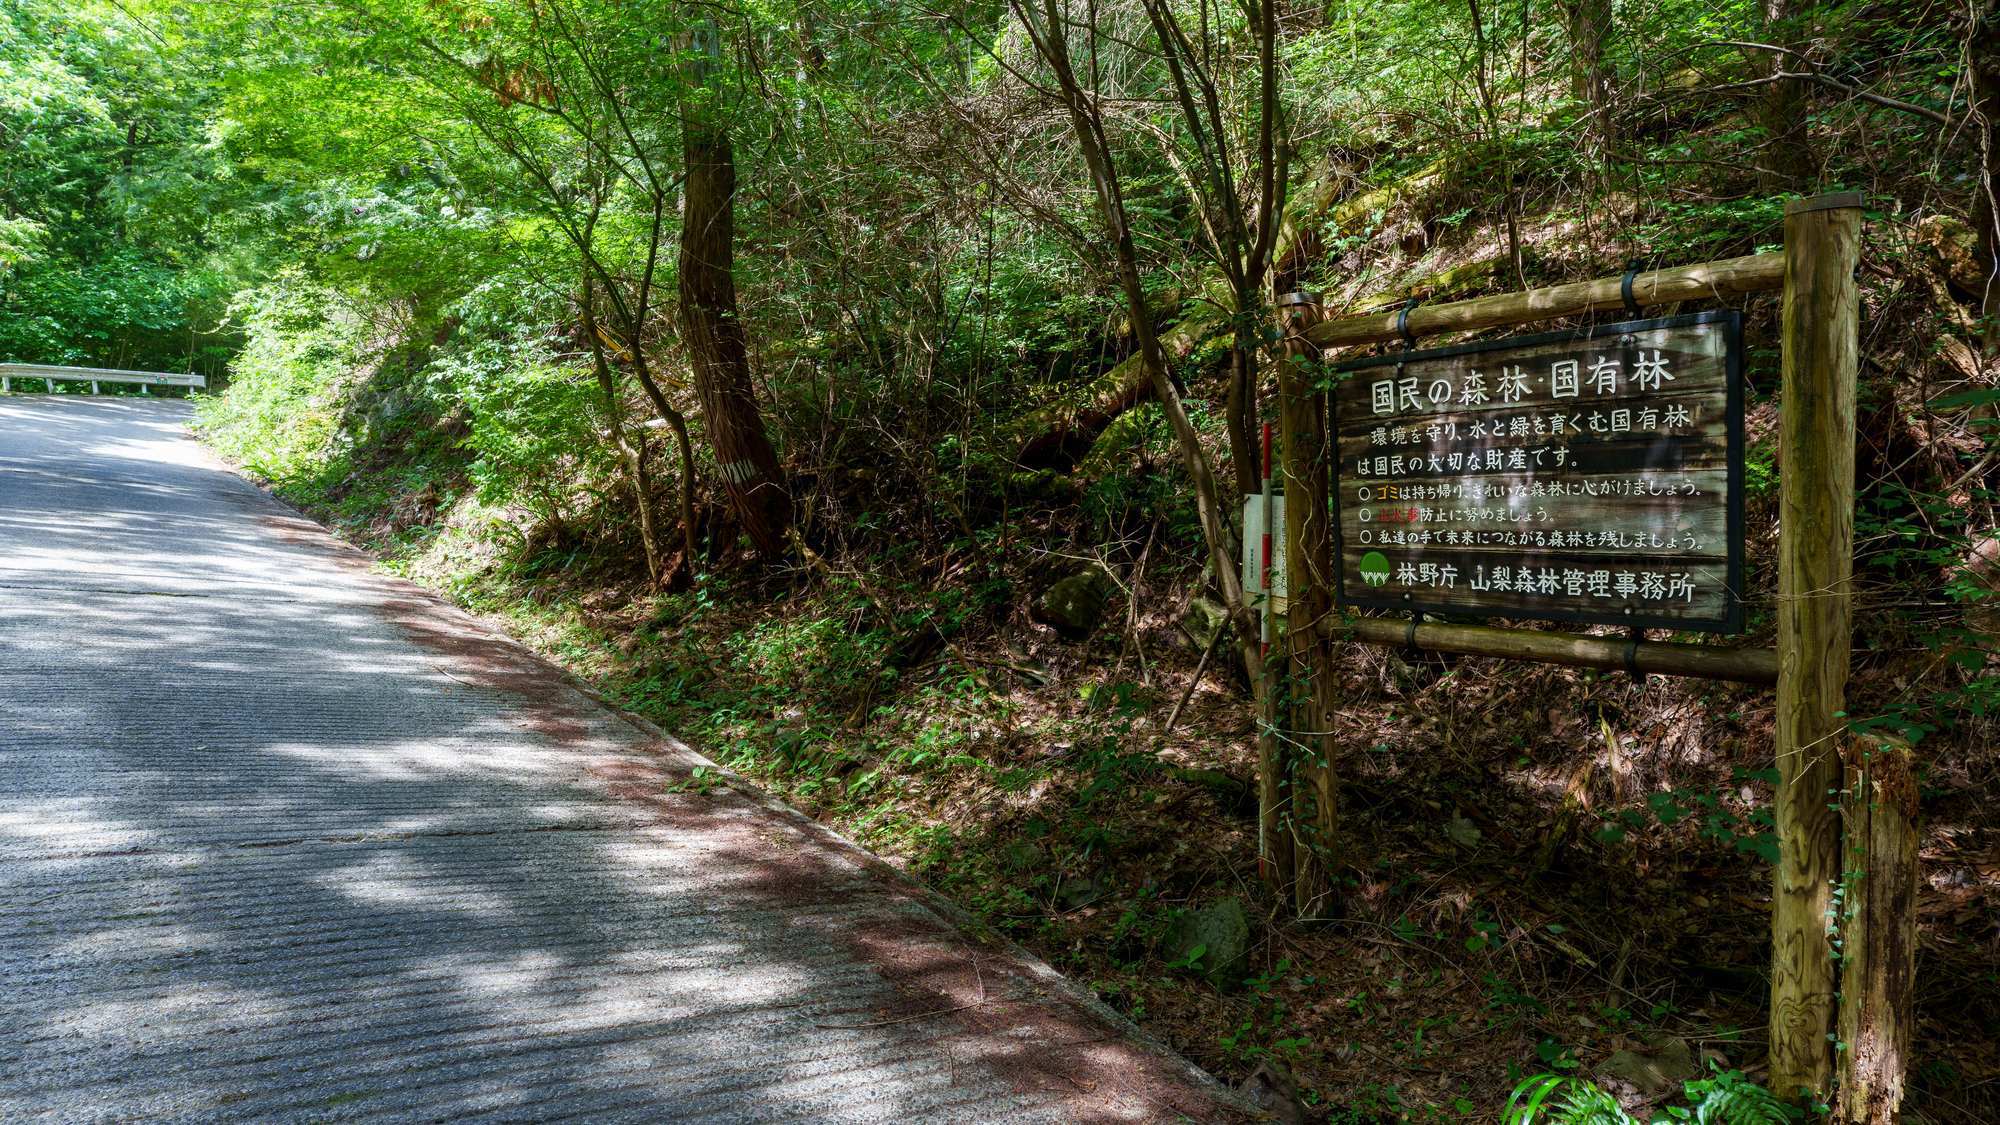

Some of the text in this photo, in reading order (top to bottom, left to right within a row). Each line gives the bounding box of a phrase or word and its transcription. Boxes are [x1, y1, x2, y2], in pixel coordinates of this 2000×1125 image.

[1357, 445, 1577, 476] は国民の大切な財産です。
[1396, 562, 1696, 602] 林野庁 山梨森林管理事務所
